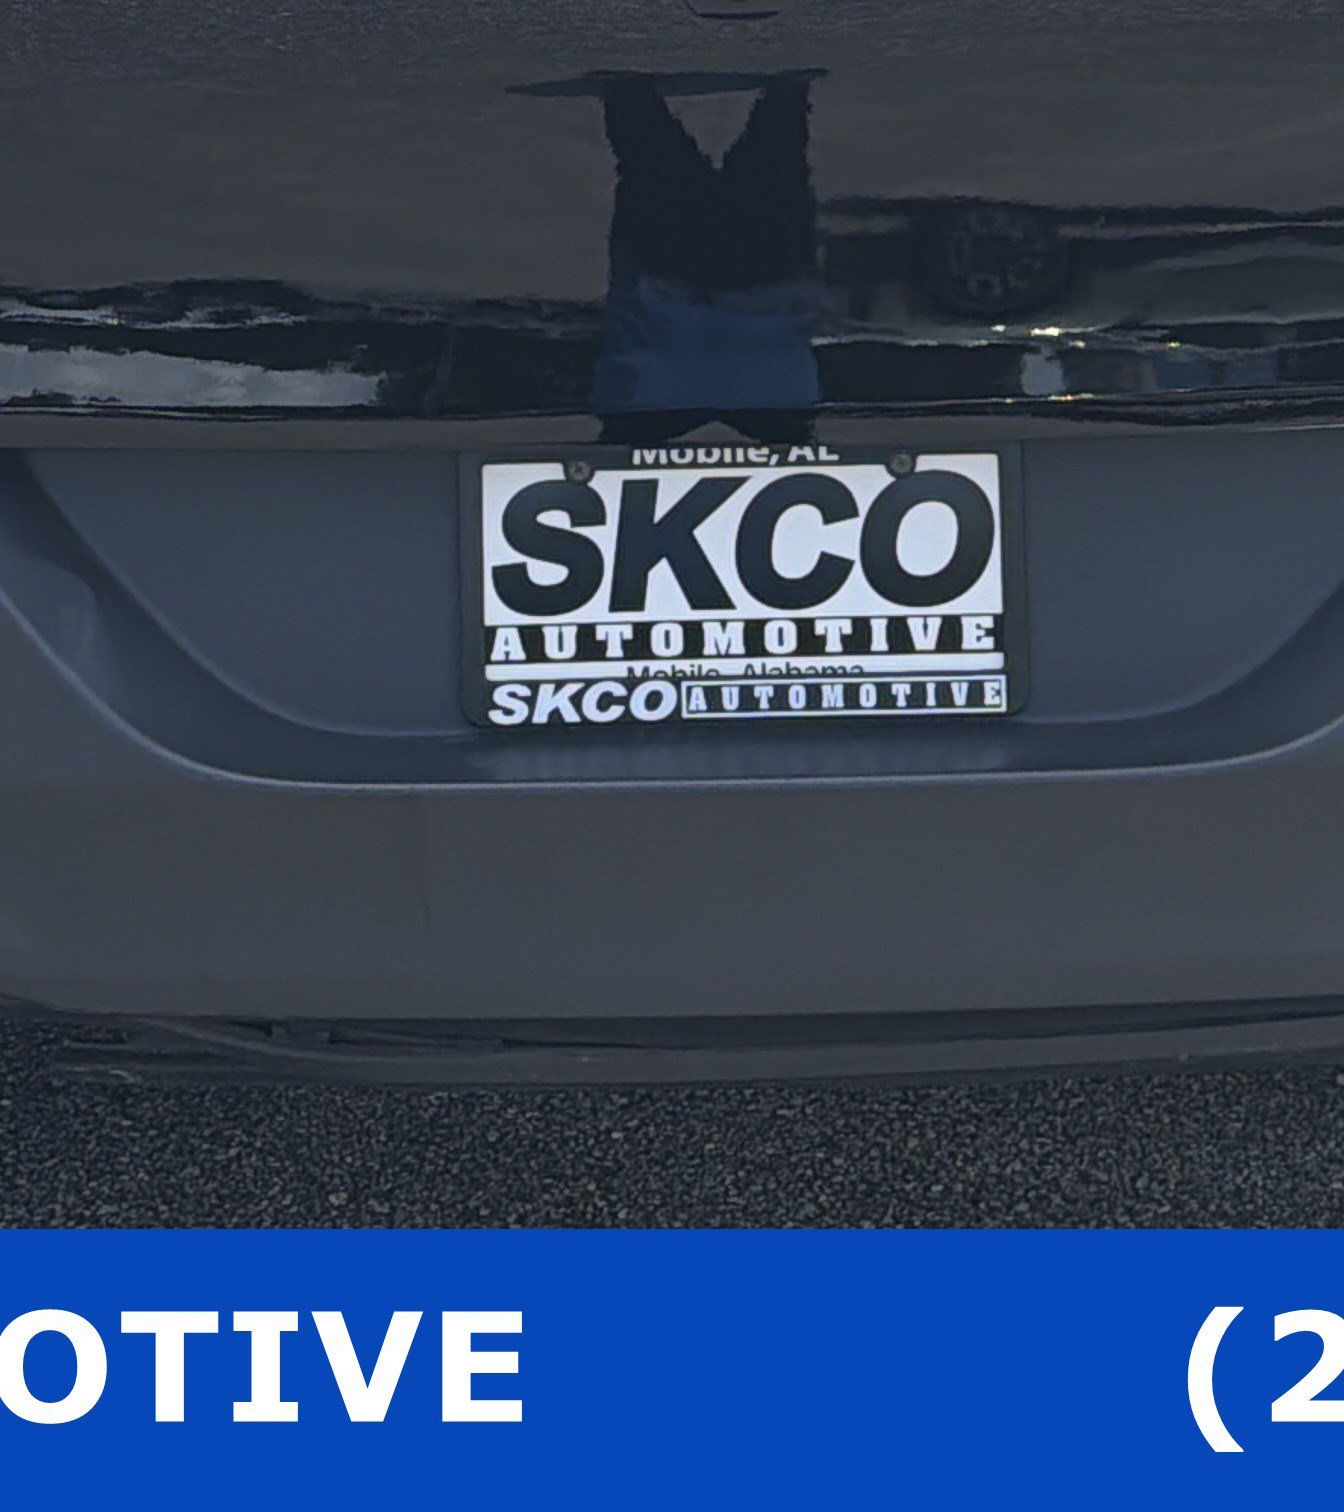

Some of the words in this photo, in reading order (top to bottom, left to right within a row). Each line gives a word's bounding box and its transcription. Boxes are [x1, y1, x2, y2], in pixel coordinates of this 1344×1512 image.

[490, 470, 996, 618] SKCO
[490, 616, 996, 661] AUTOMOTIVE
[488, 680, 678, 726] SKCO
[688, 682, 1002, 713] AUTOMOTIVE
